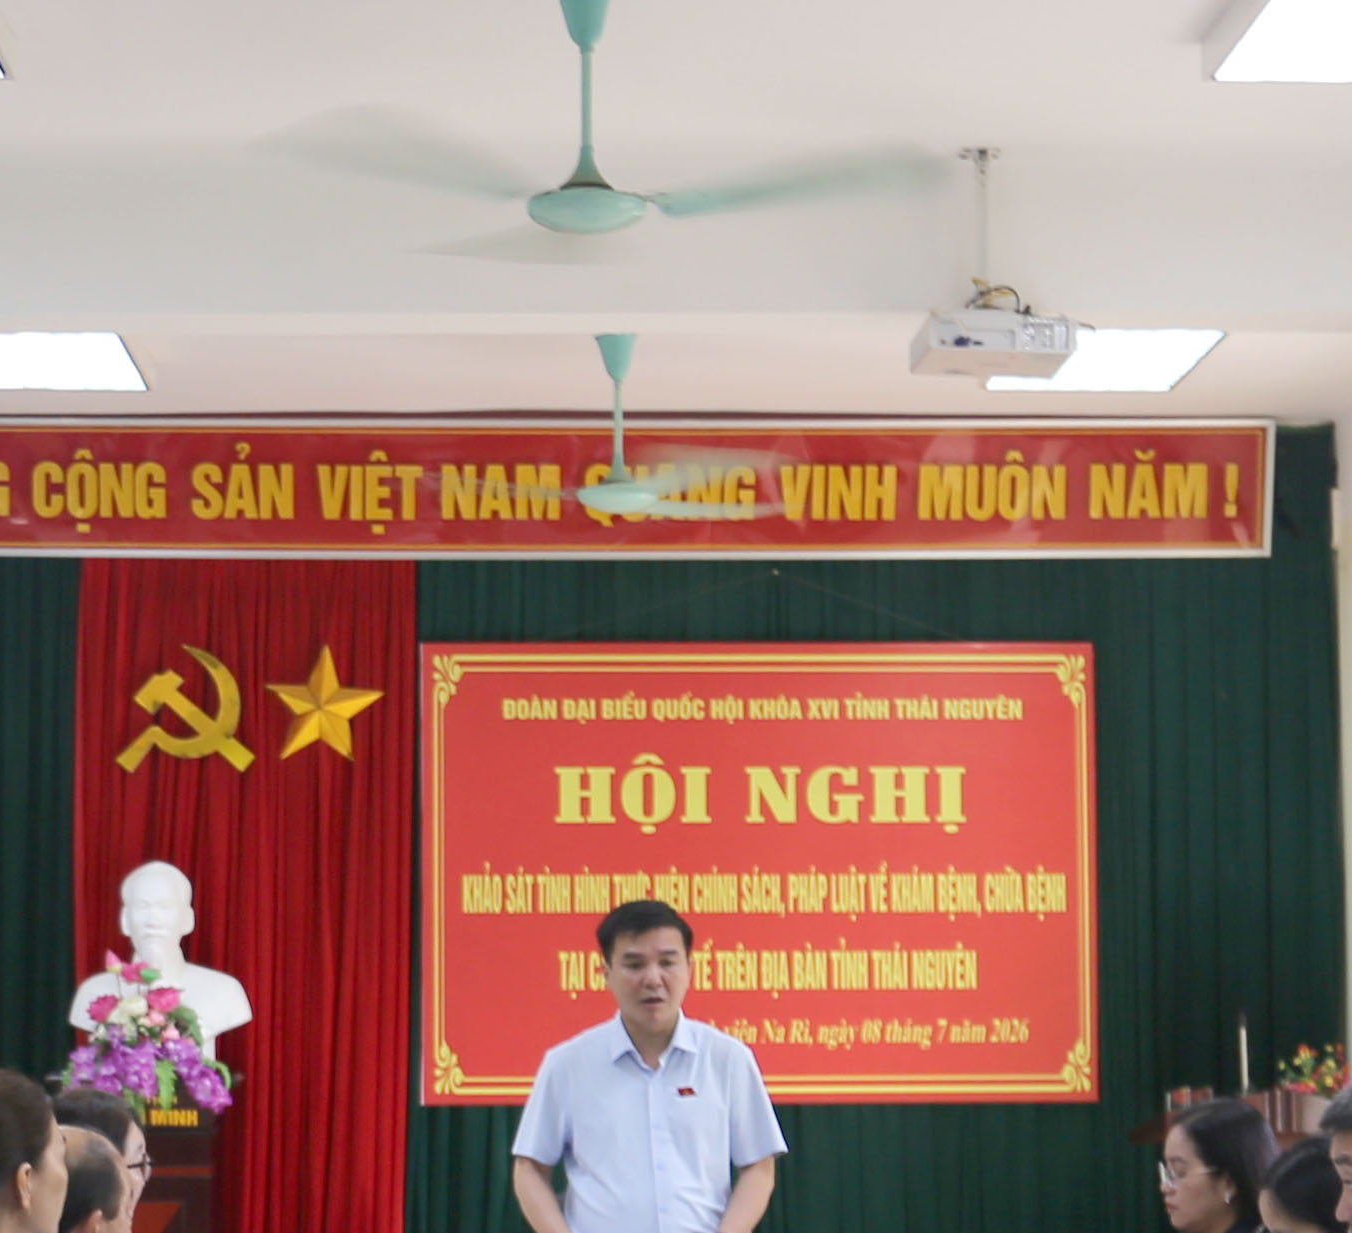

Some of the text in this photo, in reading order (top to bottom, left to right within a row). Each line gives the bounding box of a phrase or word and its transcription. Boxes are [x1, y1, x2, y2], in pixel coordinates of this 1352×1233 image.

[32, 449, 167, 533] CỘNG
[191, 442, 294, 520] SẢN
[318, 451, 424, 534] VIỆT
[442, 464, 560, 521] NAM
[780, 464, 897, 521] VINH
[918, 451, 1067, 521] MUÔN
[1089, 450, 1208, 519] NĂM
[502, 691, 1024, 724] ĐOÀN ĐẠI BIỂU QUỐC HỘI KHÓA XVI TỈNH THÁI NGUYÊN
[554, 753, 968, 833] HỘI NGHỊ
[462, 862, 503, 914] KHẢO
[506, 866, 534, 914] SÁT
[537, 867, 572, 914] TÌNH
[574, 867, 611, 914] HÌNH
[693, 865, 739, 914] CHÍNH
[788, 865, 828, 914] PHÁP
[831, 865, 868, 922] LUẬT
[869, 861, 889, 914] VỀ
[891, 865, 935, 914] KHÁM
[984, 865, 1025, 914] CHỮA
[1027, 865, 1067, 922] BỆNH
[558, 950, 585, 1000] TẠI
[692, 938, 713, 991] TẾ
[716, 941, 757, 991] TRÊN
[761, 950, 790, 999] ĐỊA
[793, 941, 828, 991] BÀN
[831, 937, 869, 991] TỈNH
[872, 941, 908, 991] THÁI
[912, 941, 978, 991] NGUYÊN
[762, 1018, 786, 1044] Na
[817, 1018, 856, 1050] ngày
[860, 1019, 883, 1043] 08
[885, 1019, 933, 1050] tháng
[937, 1019, 948, 1043] 7
[949, 1019, 987, 1043] năm
[989, 1018, 1030, 1043] 2026
[150, 1109, 198, 1127] MINH
